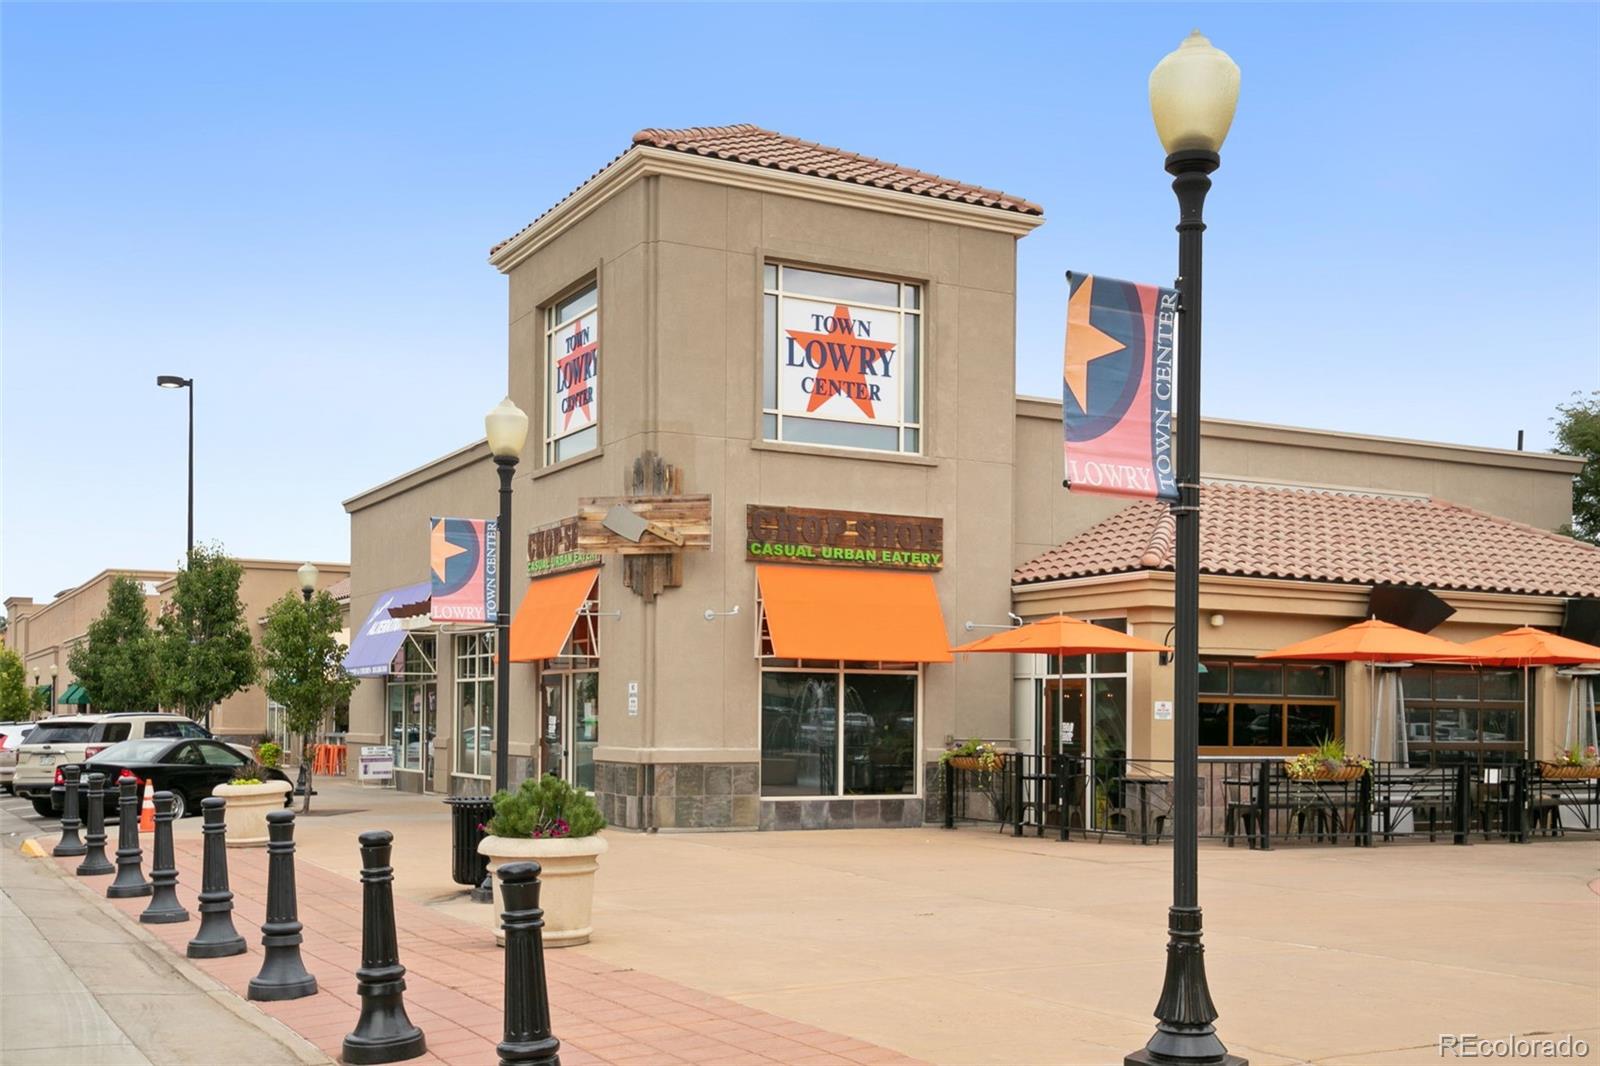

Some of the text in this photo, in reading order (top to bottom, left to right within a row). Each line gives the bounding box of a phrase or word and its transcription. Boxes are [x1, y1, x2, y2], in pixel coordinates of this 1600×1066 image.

[566, 327, 590, 354] TOWN
[811, 314, 872, 337] TOWN
[556, 348, 598, 394] LOWRY
[786, 336, 896, 377] LOWRY
[561, 386, 593, 414] CENTER
[801, 376, 881, 401] CENTER
[1155, 293, 1178, 490] TOWN CENTER
[1069, 459, 1152, 491] LOWRY
[528, 527, 562, 562] CHOP
[750, 509, 937, 551] CHOP SHOP
[751, 542, 941, 565] CASUAL URBAN EATERY
[486, 522, 497, 618] TOWN CENTER
[433, 606, 484, 619] LOWRY
